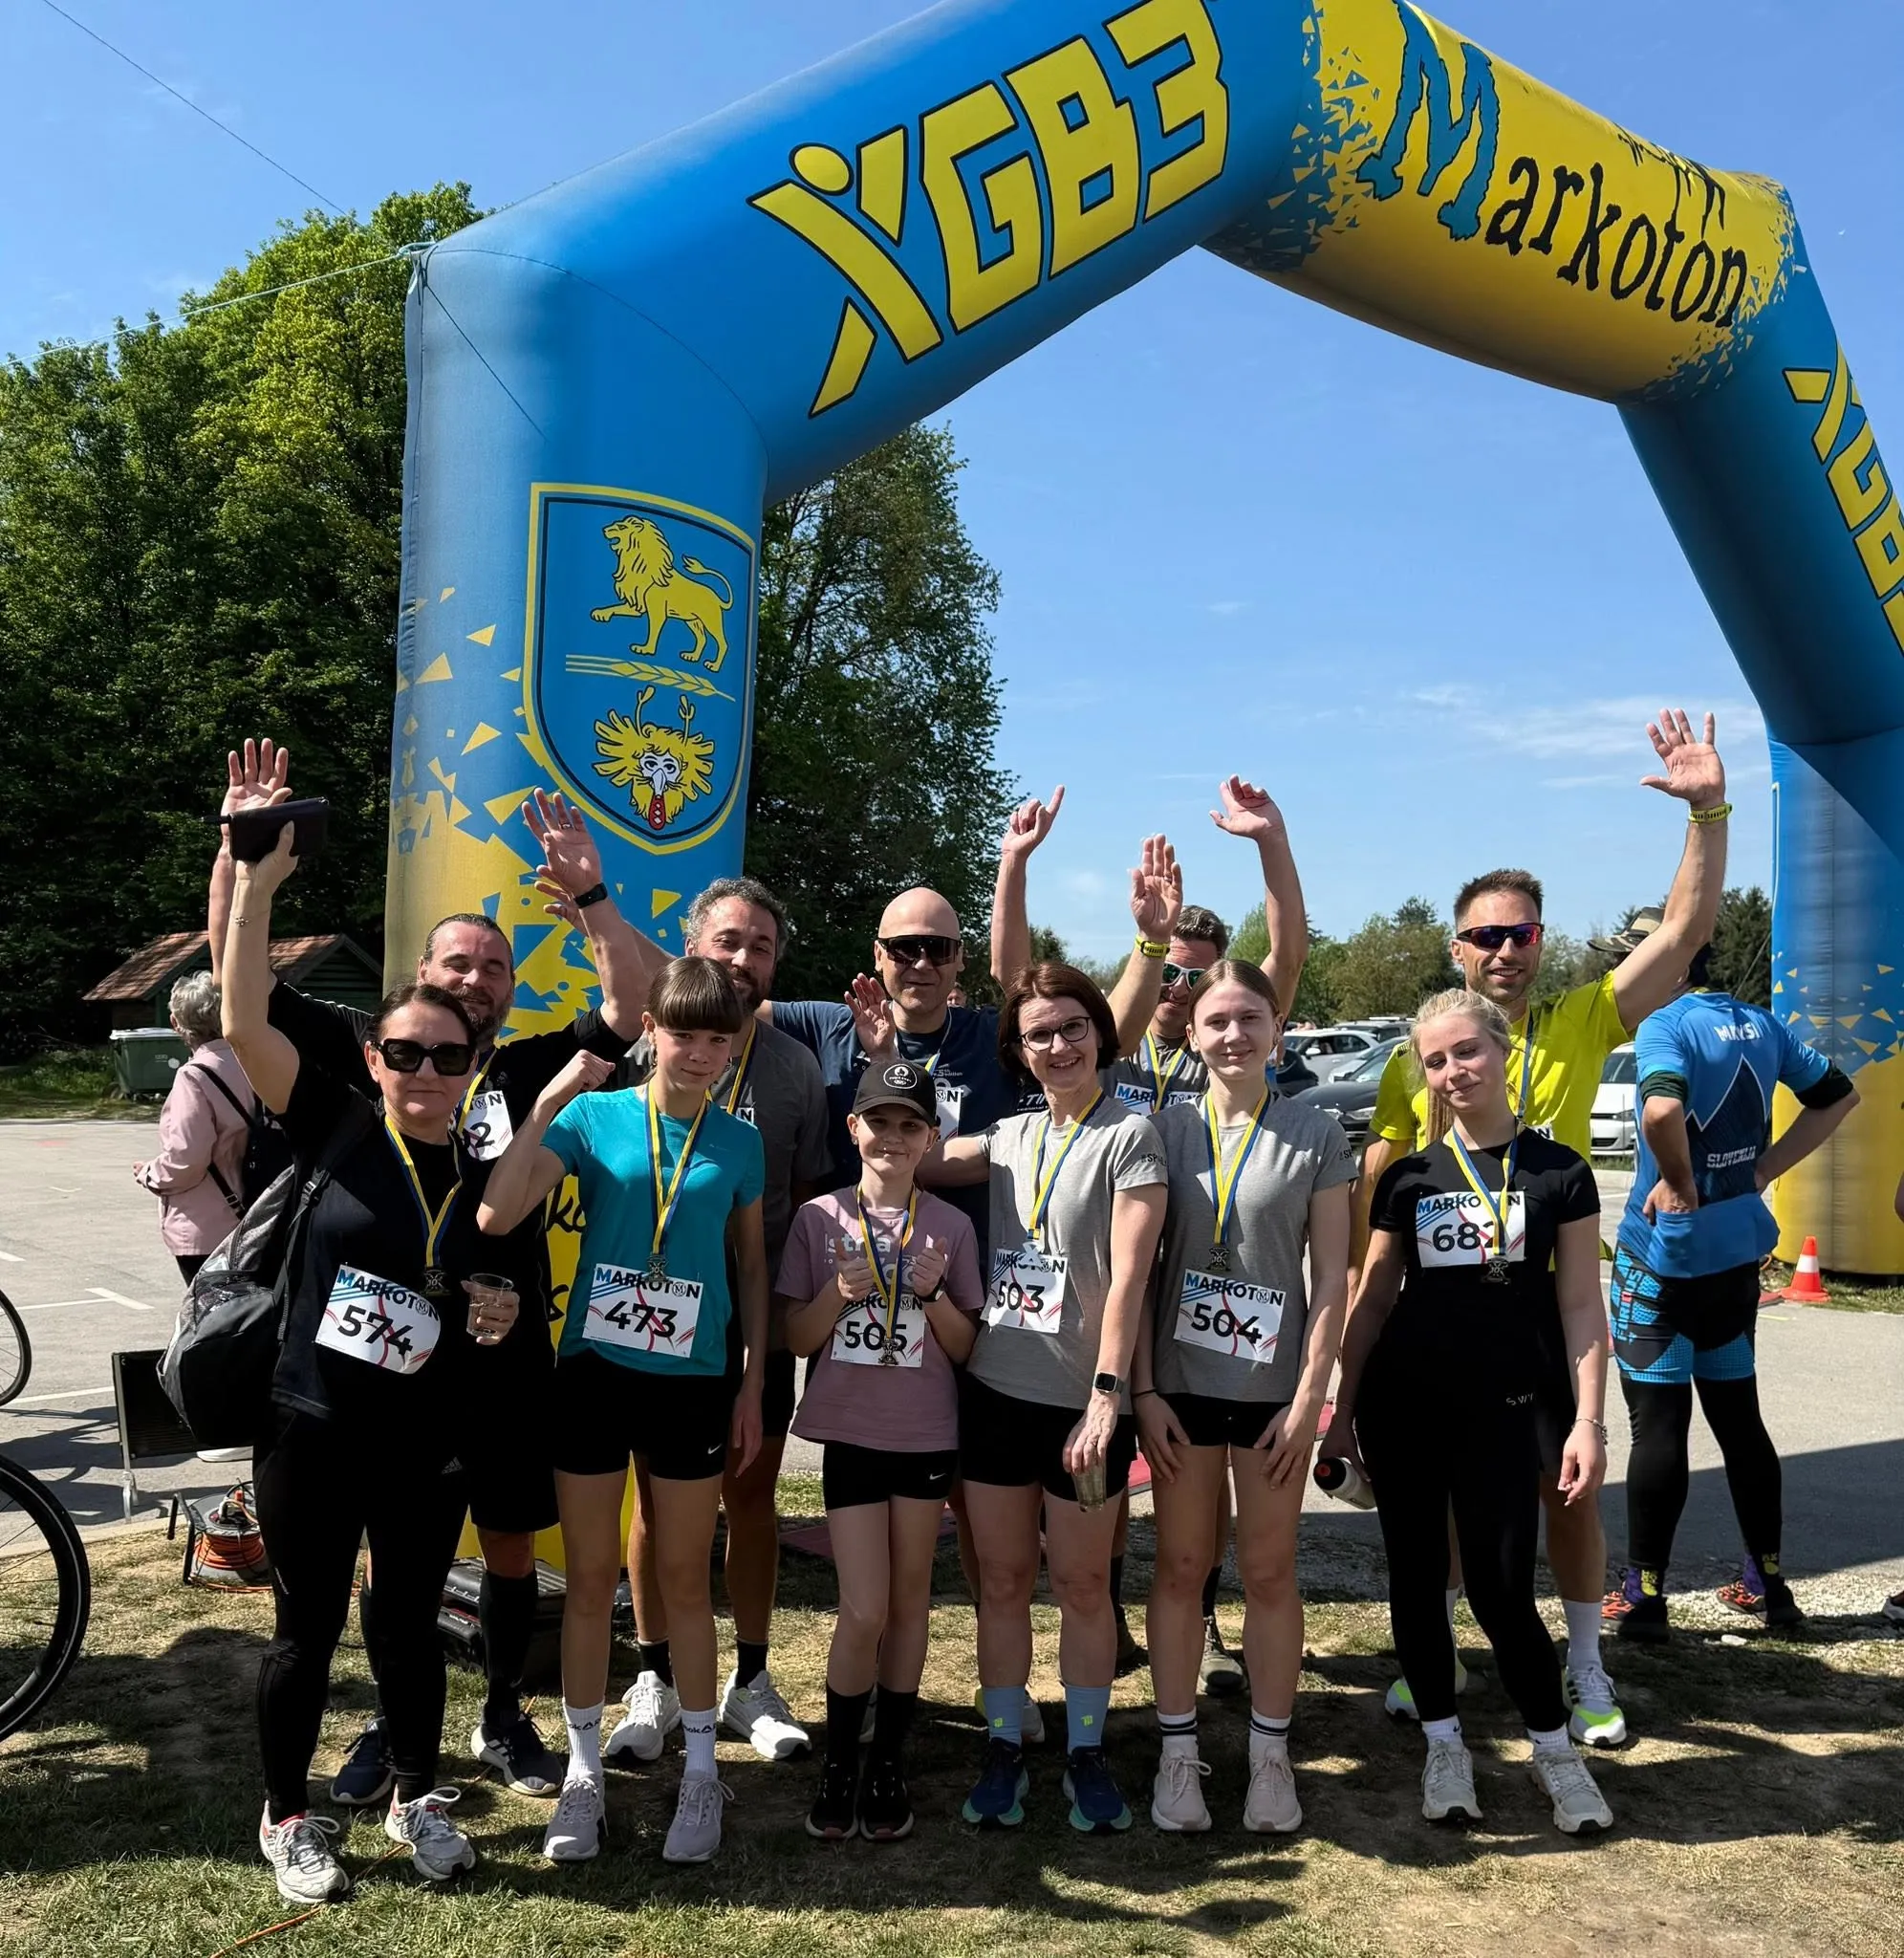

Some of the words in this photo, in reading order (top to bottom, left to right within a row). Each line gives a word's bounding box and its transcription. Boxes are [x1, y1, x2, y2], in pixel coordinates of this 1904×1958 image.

[1356, 0, 1746, 327] Markoton
[996, 1279, 1046, 1314] 503
[337, 1304, 414, 1356] 574
[604, 1300, 678, 1338] 473
[845, 1320, 907, 1351] 505
[1191, 1302, 1263, 1344] 504
